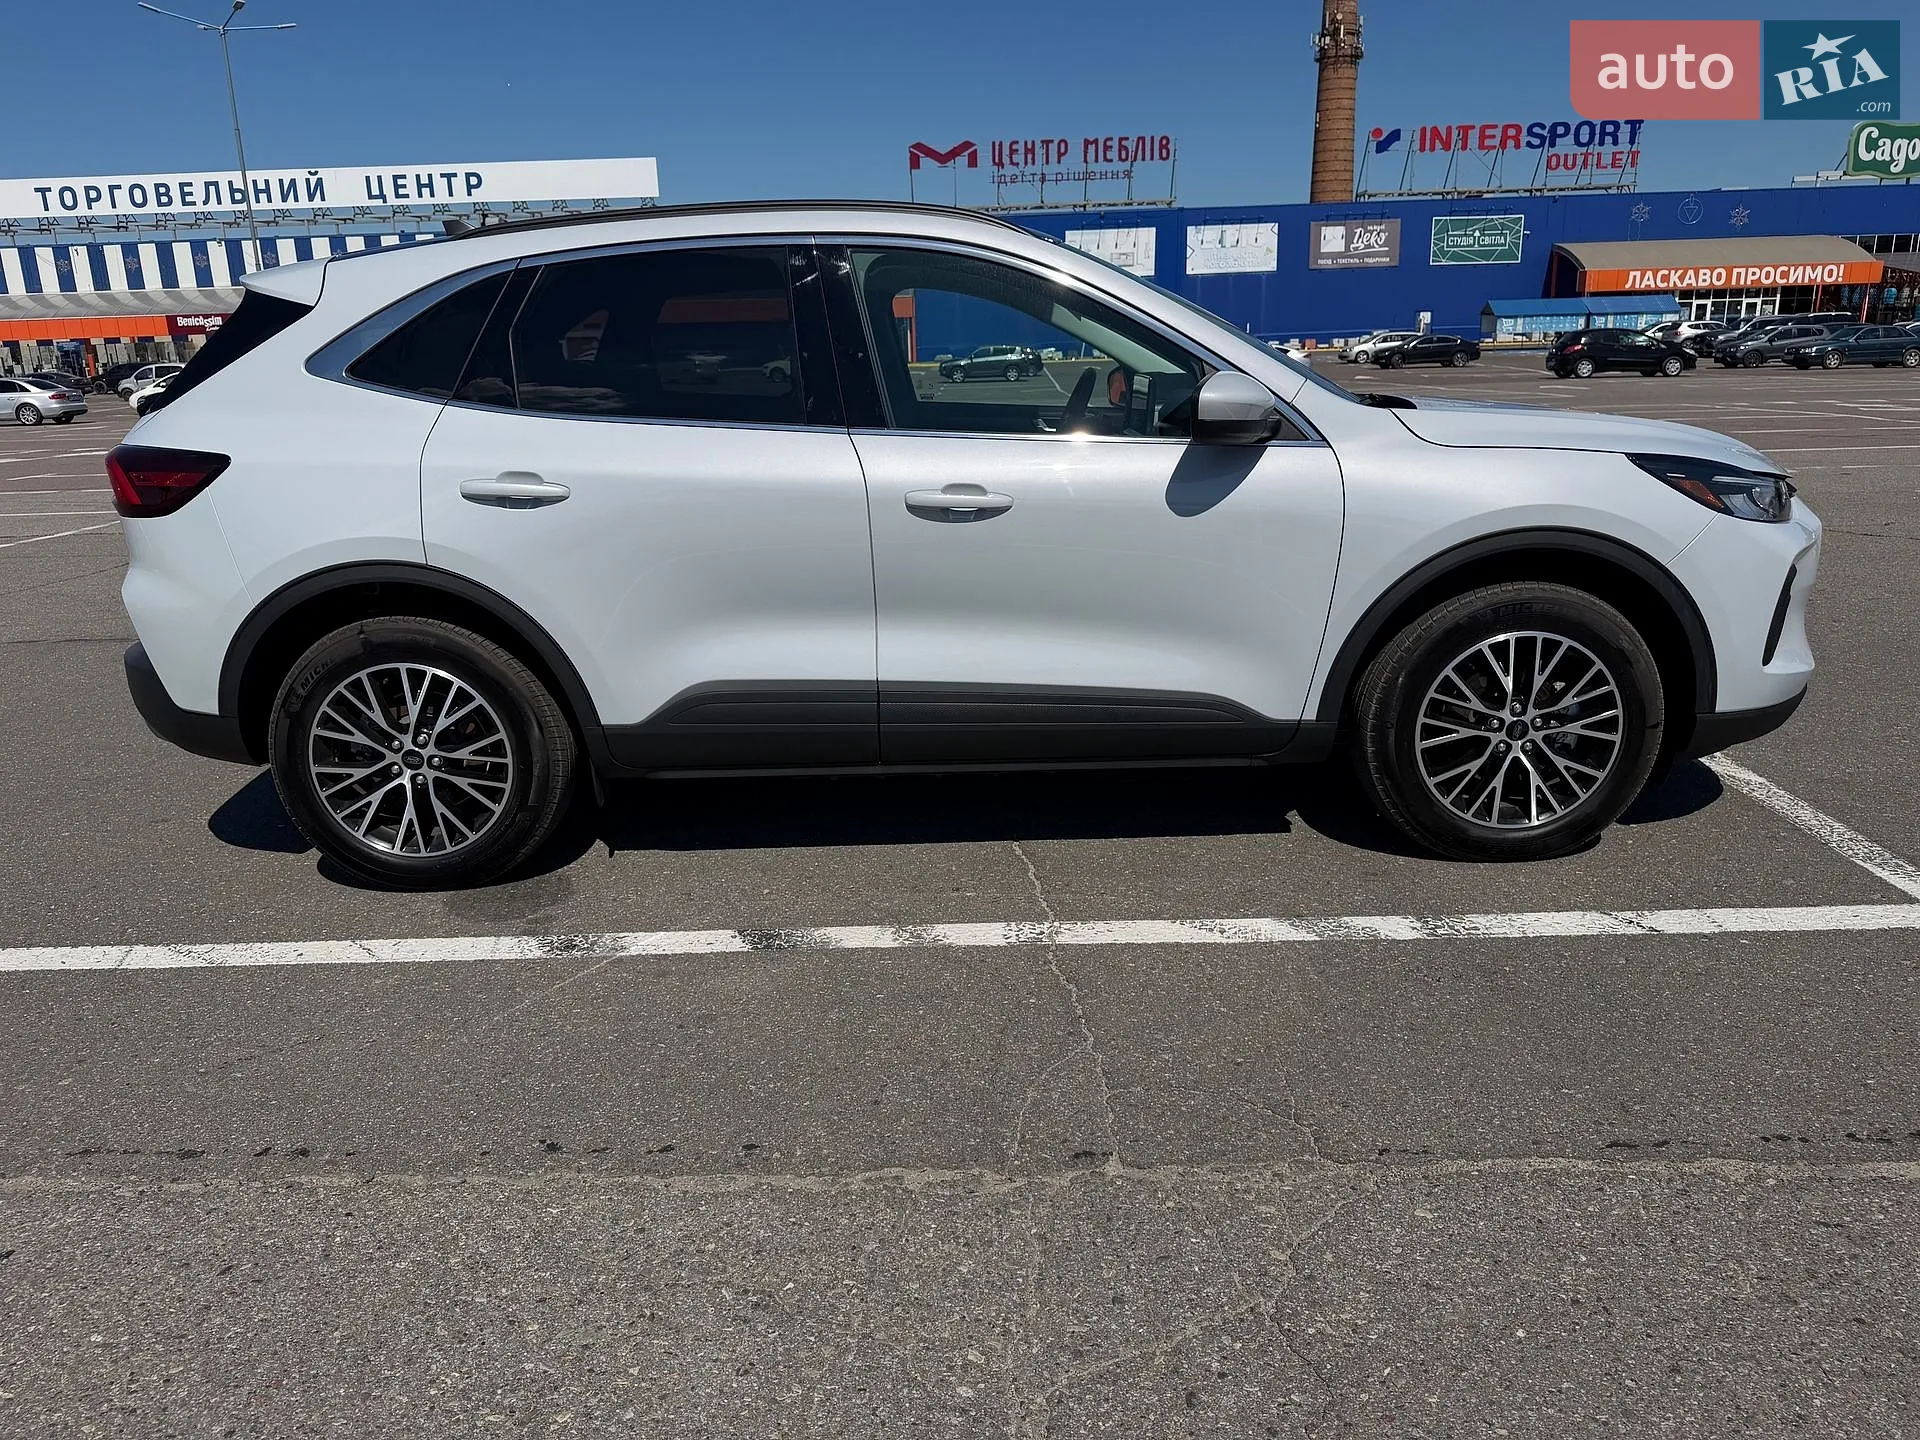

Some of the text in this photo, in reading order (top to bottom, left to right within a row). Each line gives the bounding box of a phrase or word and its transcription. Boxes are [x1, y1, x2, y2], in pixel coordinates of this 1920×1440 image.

[1418, 119, 1644, 152] INTERSPORT
[991, 135, 1171, 169] ЦЕНТР МЕБЛІВ
[1547, 150, 1640, 171] OUTLET
[1055, 168, 1132, 186] рішення
[34, 170, 483, 212] ТОРГОВЕЛЬНИЙ ЦЕНТР
[1448, 235, 1505, 246] СТУДІЯ СВІТЛА
[1625, 263, 1845, 289] ЛАСКАВО ПРОСИМО!
